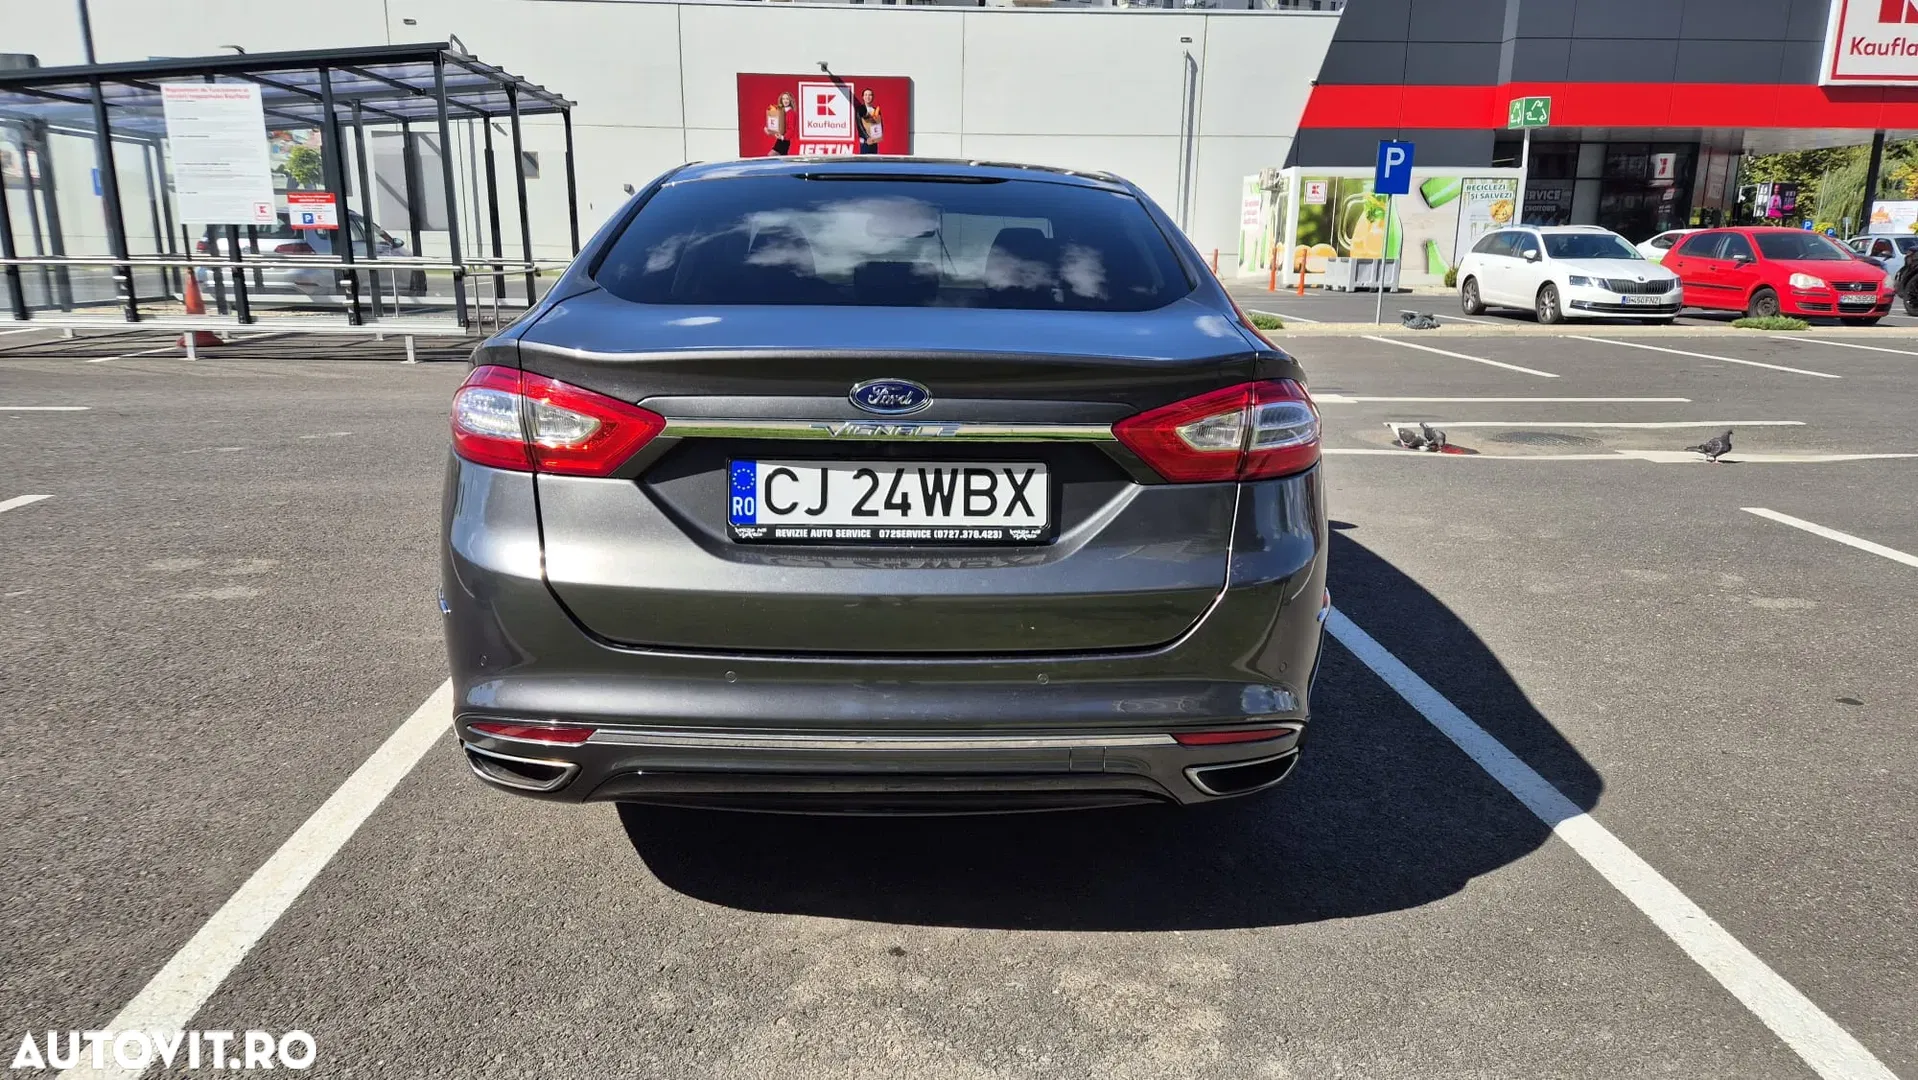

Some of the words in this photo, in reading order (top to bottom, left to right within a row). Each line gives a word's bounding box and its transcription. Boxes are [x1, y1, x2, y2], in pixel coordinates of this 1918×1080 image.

[807, 121, 846, 129] Kaufland
[1384, 147, 1405, 178] P
[1466, 183, 1506, 191] RECICLEZI
[1804, 221, 1811, 230] P
[1827, 228, 1834, 236] P
[868, 386, 913, 405] Ford
[764, 467, 829, 516] CJ
[732, 496, 755, 516] RO
[775, 529, 808, 538] REVIZIE
[810, 529, 833, 538] AUTO
[835, 529, 871, 538] SERVICE
[879, 529, 931, 538] 072SERVICE
